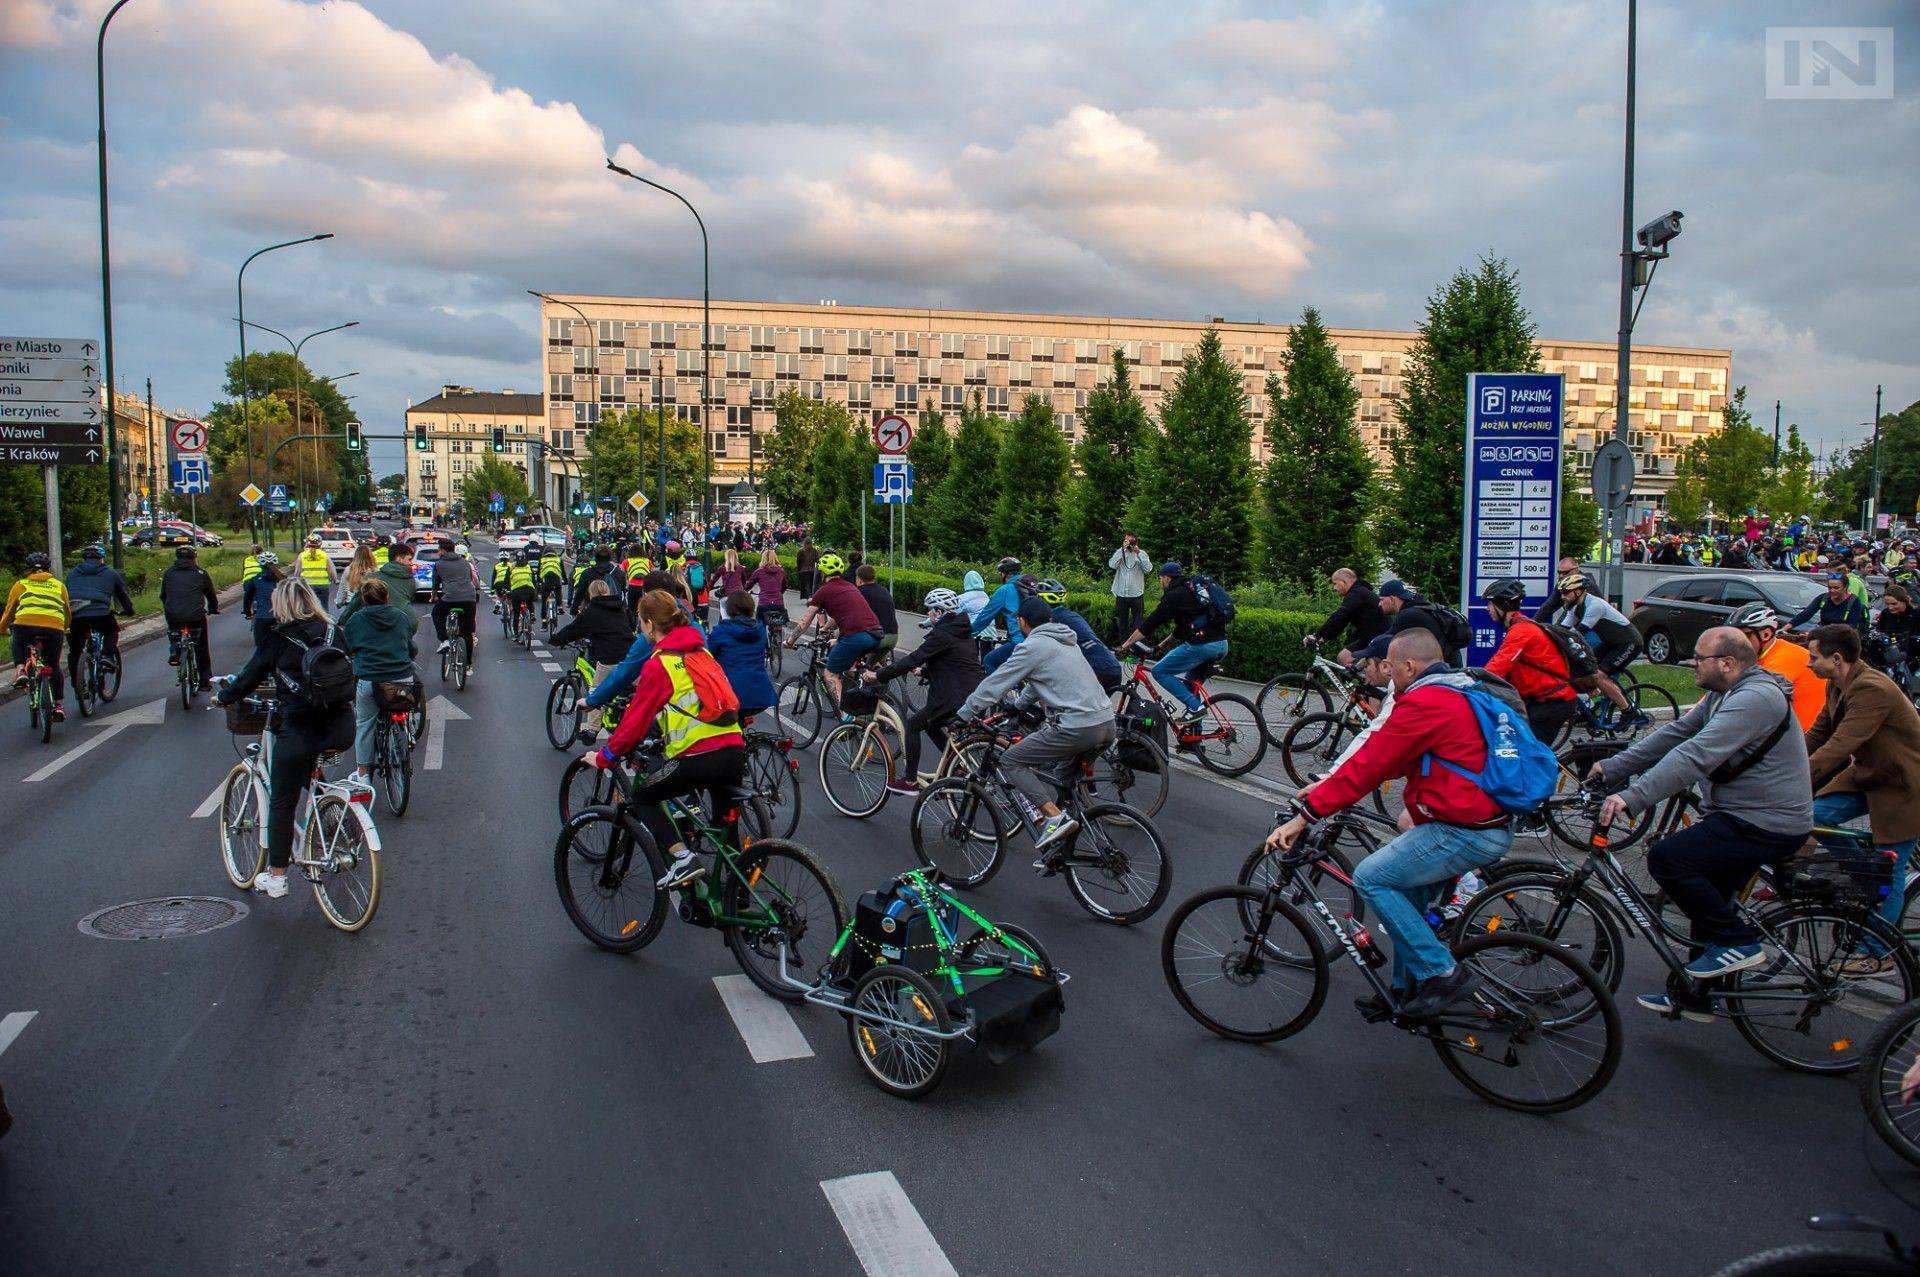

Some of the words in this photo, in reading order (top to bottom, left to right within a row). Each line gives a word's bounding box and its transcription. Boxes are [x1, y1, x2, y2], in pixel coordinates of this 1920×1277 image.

[16, 341, 62, 353] Miasto
[1511, 389, 1552, 402] PARKING
[1, 405, 60, 420] ierzyniec
[1510, 405, 1524, 413] PRZY
[1526, 405, 1551, 413] MUZEUM
[1480, 420, 1509, 430] MOŻNA
[1512, 421, 1552, 430] WYGODNIEJ
[0, 426, 45, 439] Wawel
[10, 447, 59, 460] Kraków
[1500, 468, 1534, 476] CENNIK
